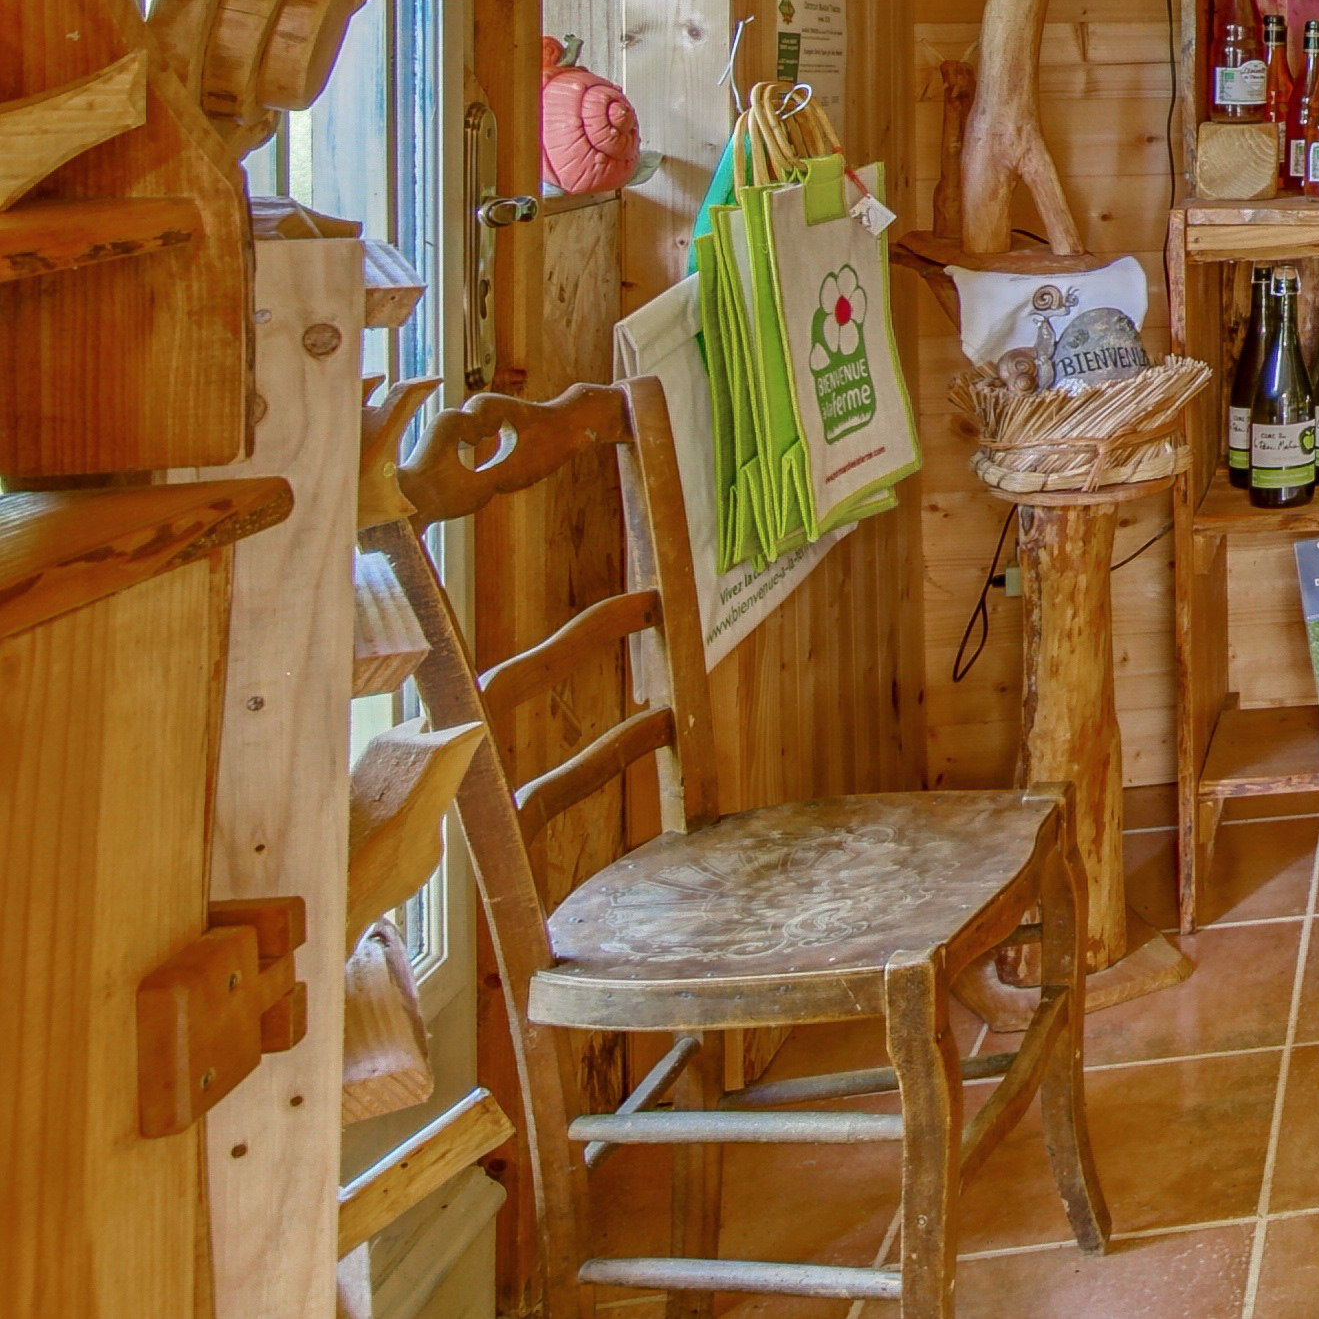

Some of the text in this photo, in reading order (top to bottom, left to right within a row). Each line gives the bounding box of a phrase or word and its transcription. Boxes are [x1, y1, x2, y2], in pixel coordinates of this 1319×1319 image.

[816, 361, 870, 398] BIENVENUE
[1057, 348, 1150, 379] BIENVENU
[831, 387, 873, 422] ferme
[719, 584, 743, 605] Vivez
